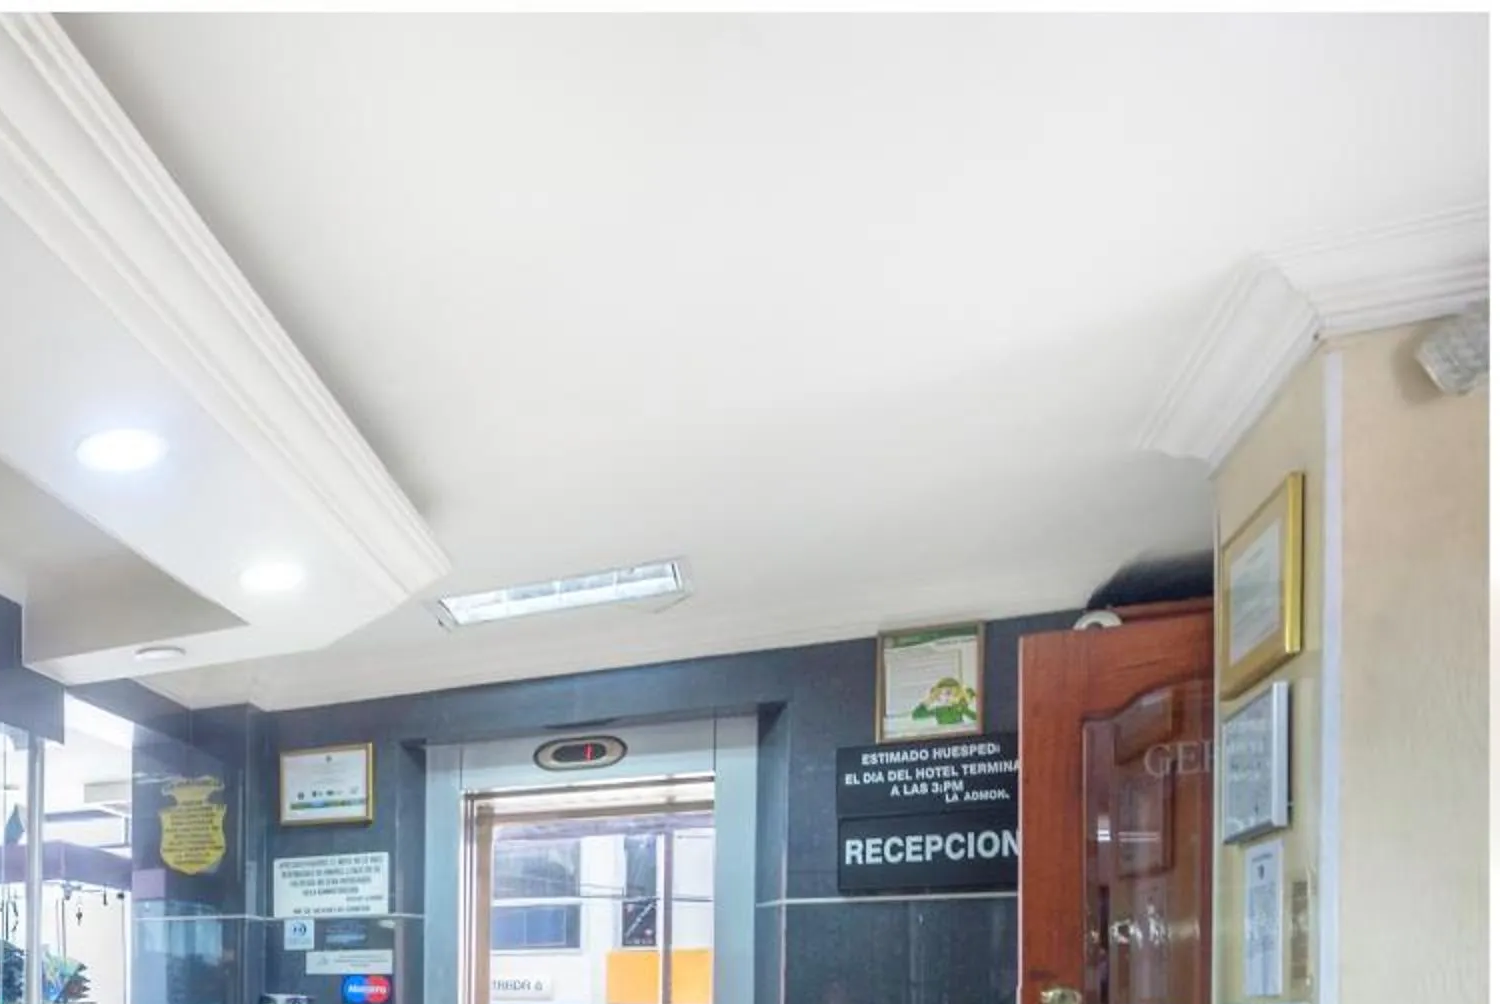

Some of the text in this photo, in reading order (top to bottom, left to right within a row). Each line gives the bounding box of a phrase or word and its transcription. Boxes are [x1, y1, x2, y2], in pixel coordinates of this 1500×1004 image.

[862, 749, 929, 766] ESTIMADO
[845, 773, 860, 785] EL
[863, 771, 884, 784] DIA
[887, 769, 912, 782] DEL
[915, 766, 958, 779] HOTEL
[890, 785, 900, 797] A
[903, 783, 929, 796] LAS
[945, 793, 959, 803] LA
[845, 828, 1020, 865] RECEPCION
